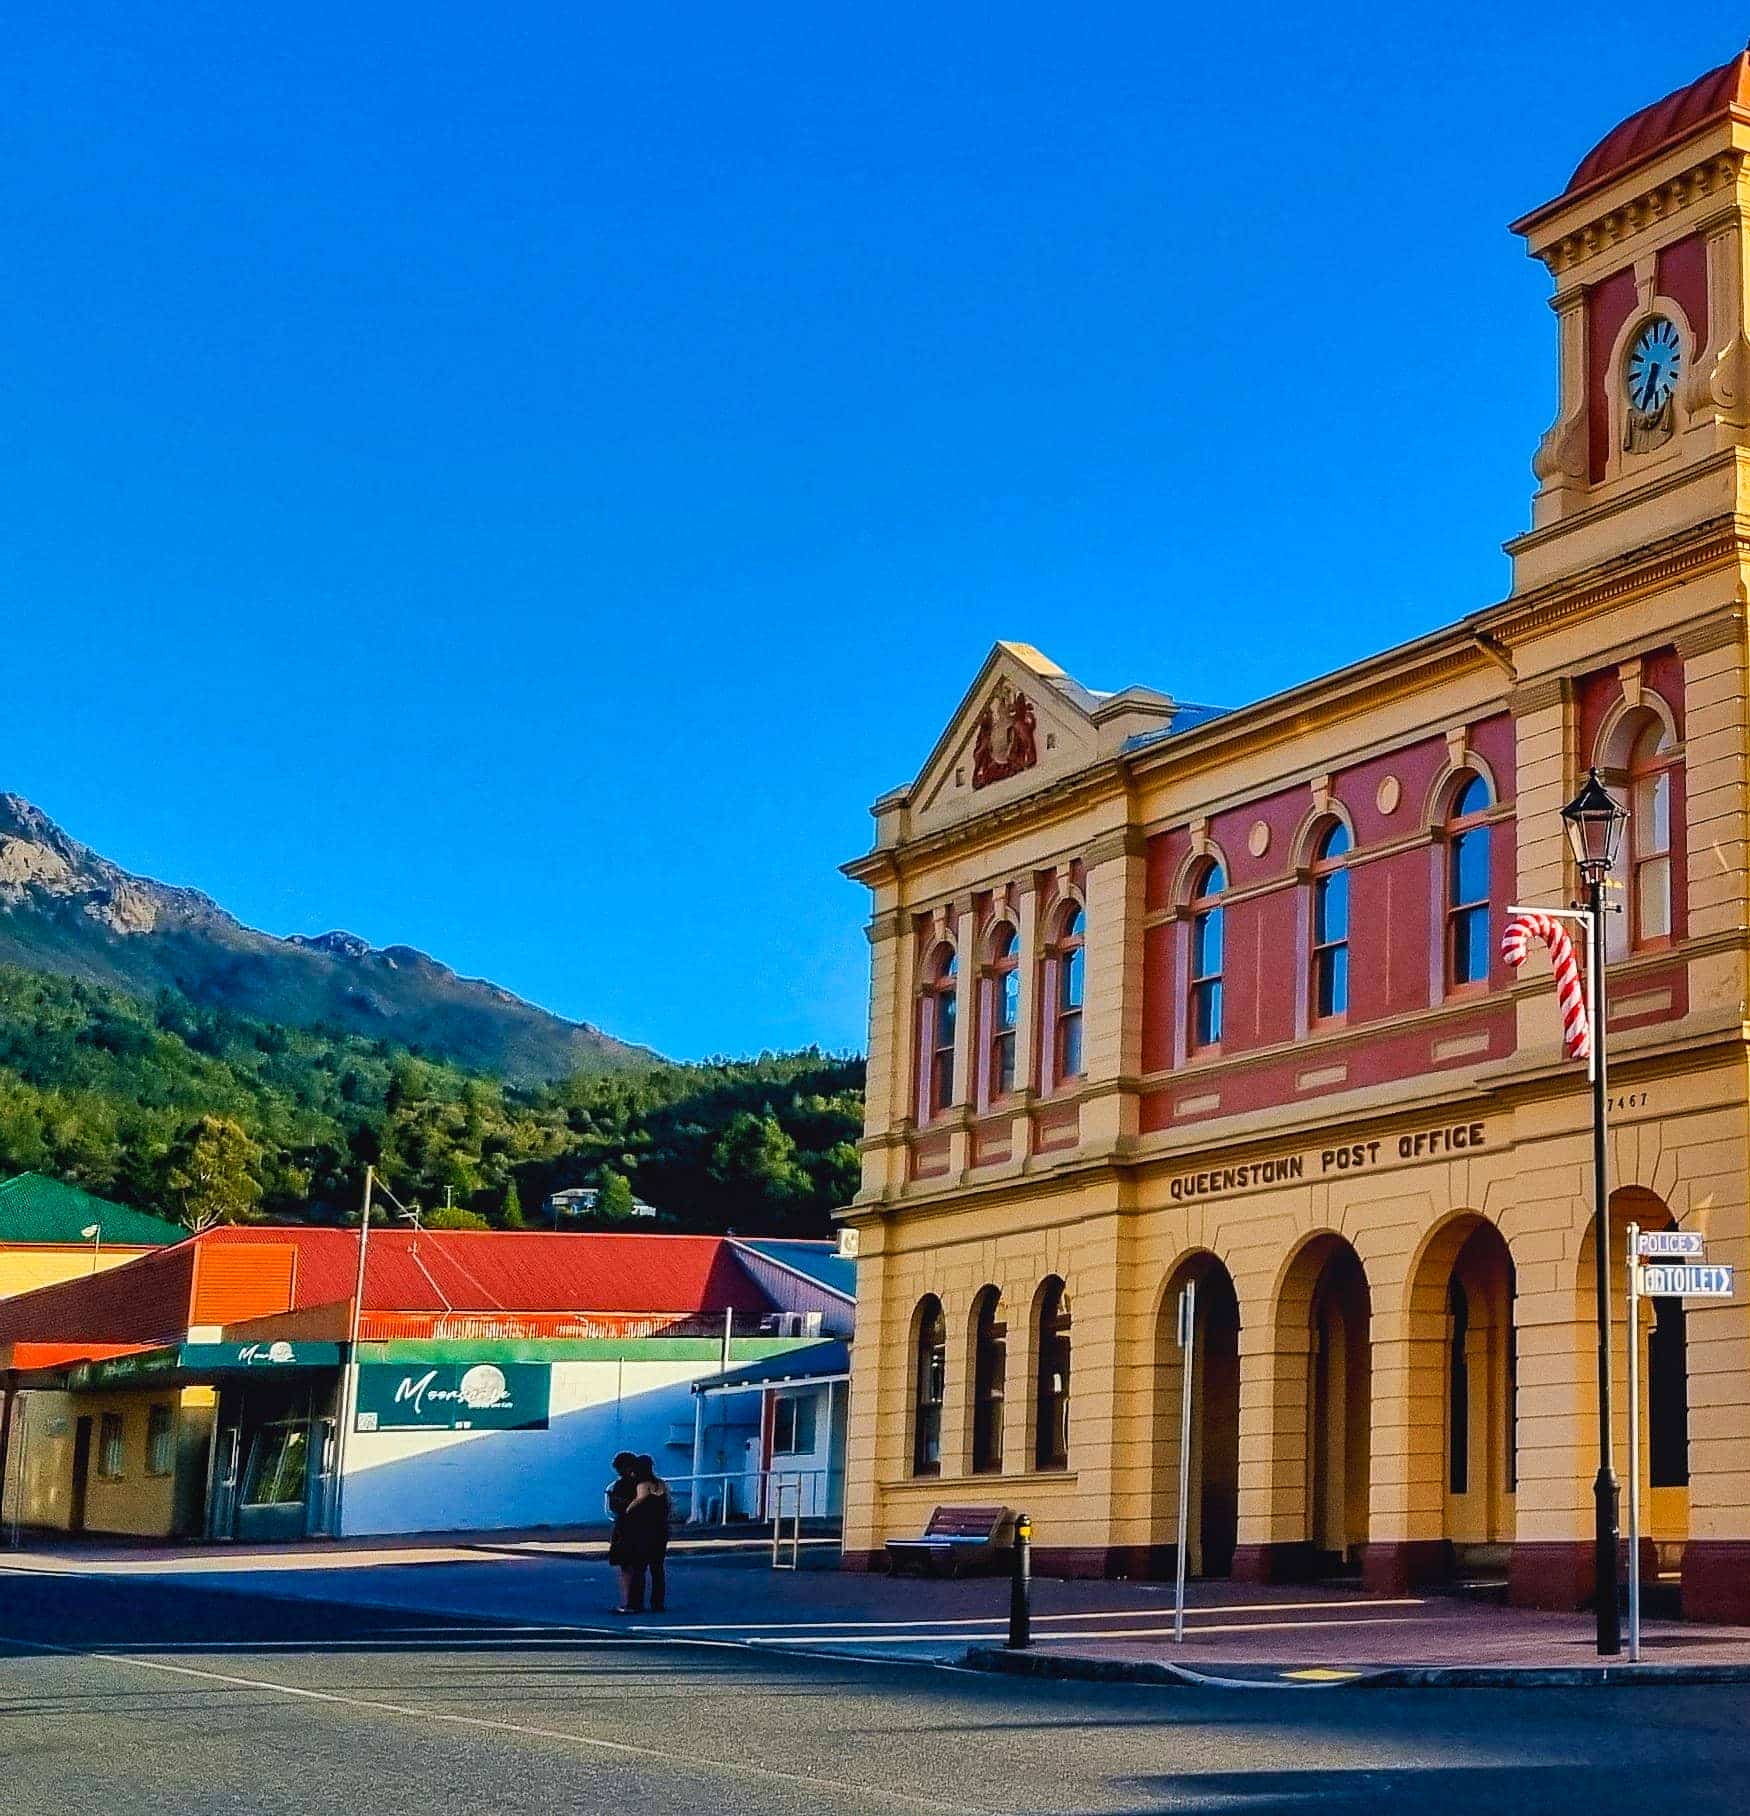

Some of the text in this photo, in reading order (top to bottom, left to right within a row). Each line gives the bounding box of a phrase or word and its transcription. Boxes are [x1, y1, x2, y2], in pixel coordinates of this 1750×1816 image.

[1607, 1093, 1647, 1112] 7467
[1170, 1121, 1486, 1200] QUEENSTOWN POST OFFICE
[1640, 1235, 1687, 1252] POLICE
[1664, 1267, 1719, 1292] TOILET
